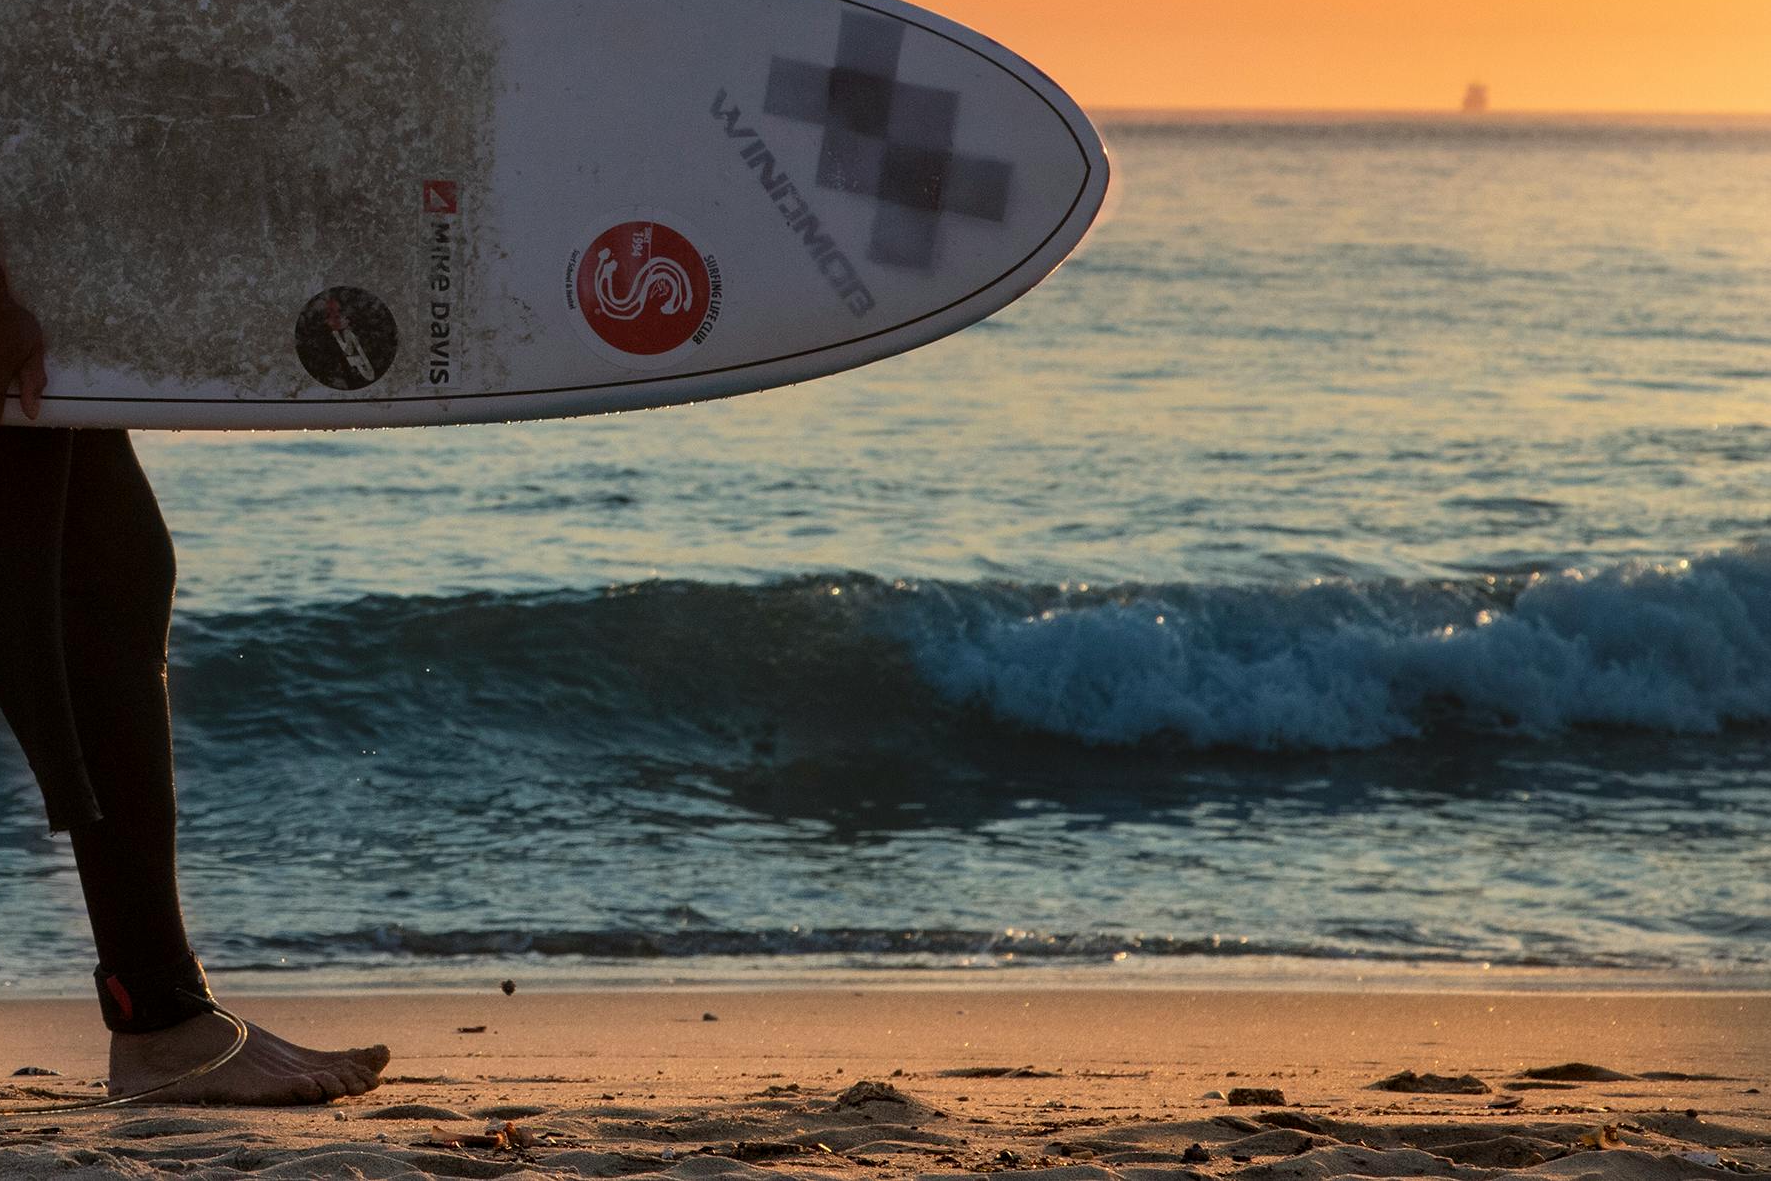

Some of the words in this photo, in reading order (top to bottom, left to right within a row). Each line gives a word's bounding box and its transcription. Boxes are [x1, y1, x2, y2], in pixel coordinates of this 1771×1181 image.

[631, 232, 644, 257] 1994
[571, 250, 580, 264] Surf
[565, 262, 576, 283] School
[703, 254, 723, 300] SURFING
[708, 301, 722, 322] LIFE
[692, 322, 714, 345] CLUB
